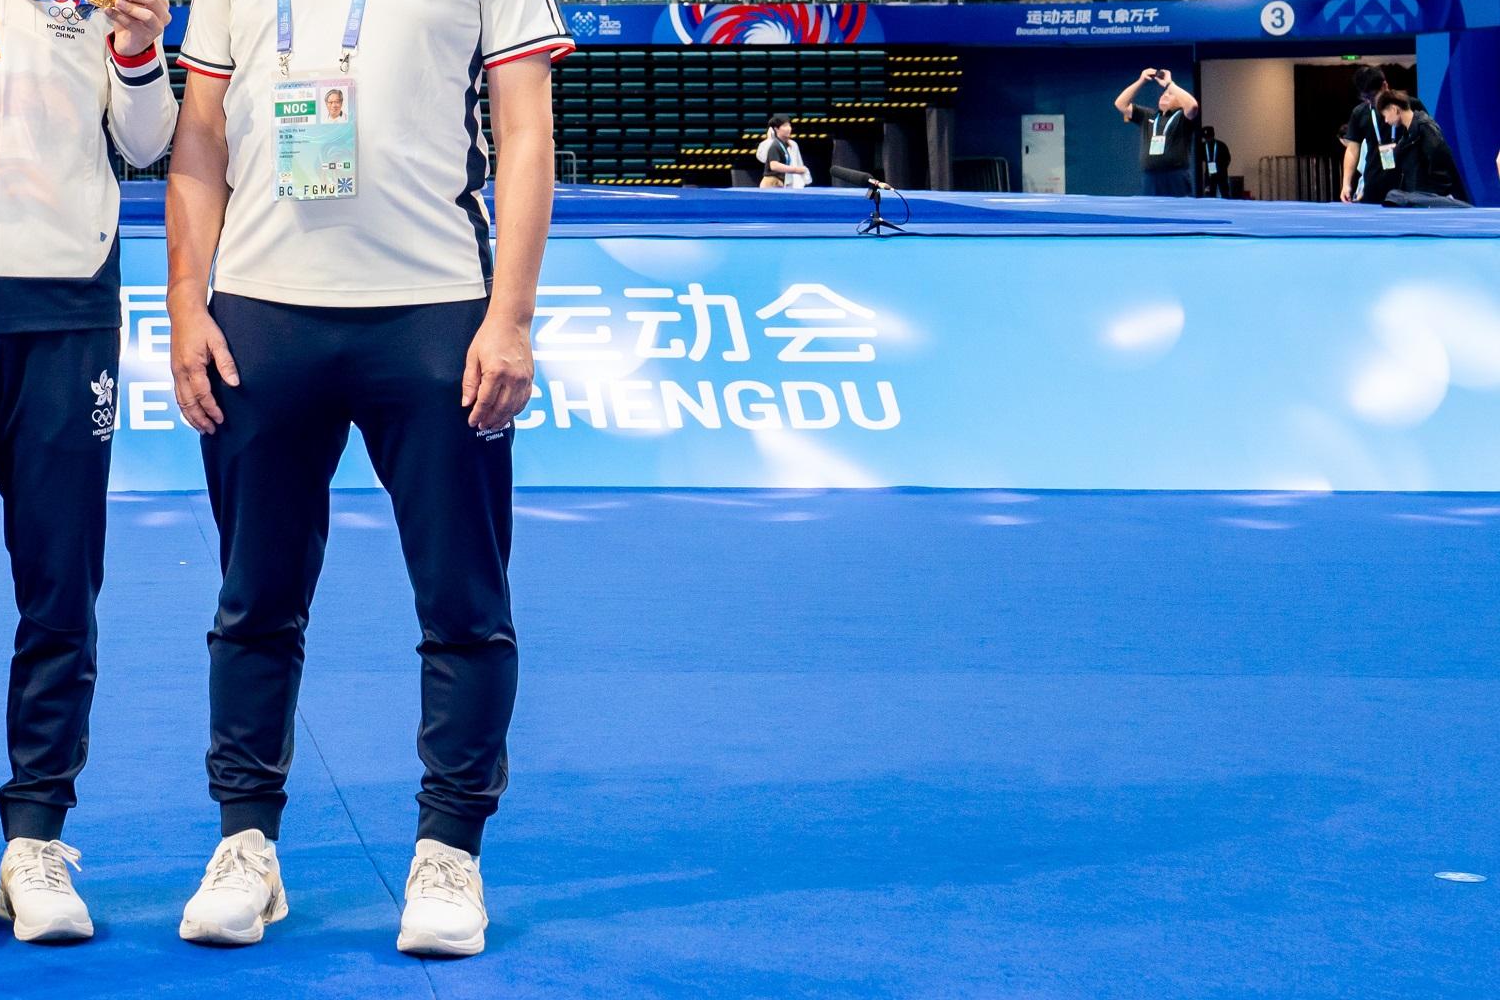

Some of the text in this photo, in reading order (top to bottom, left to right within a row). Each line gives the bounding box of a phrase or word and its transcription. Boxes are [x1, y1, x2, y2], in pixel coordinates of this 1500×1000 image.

[1270, 7, 1285, 29] 3
[46, 23, 85, 34] HONG KONG
[55, 31, 76, 40] CHINA
[283, 103, 308, 115] NOC
